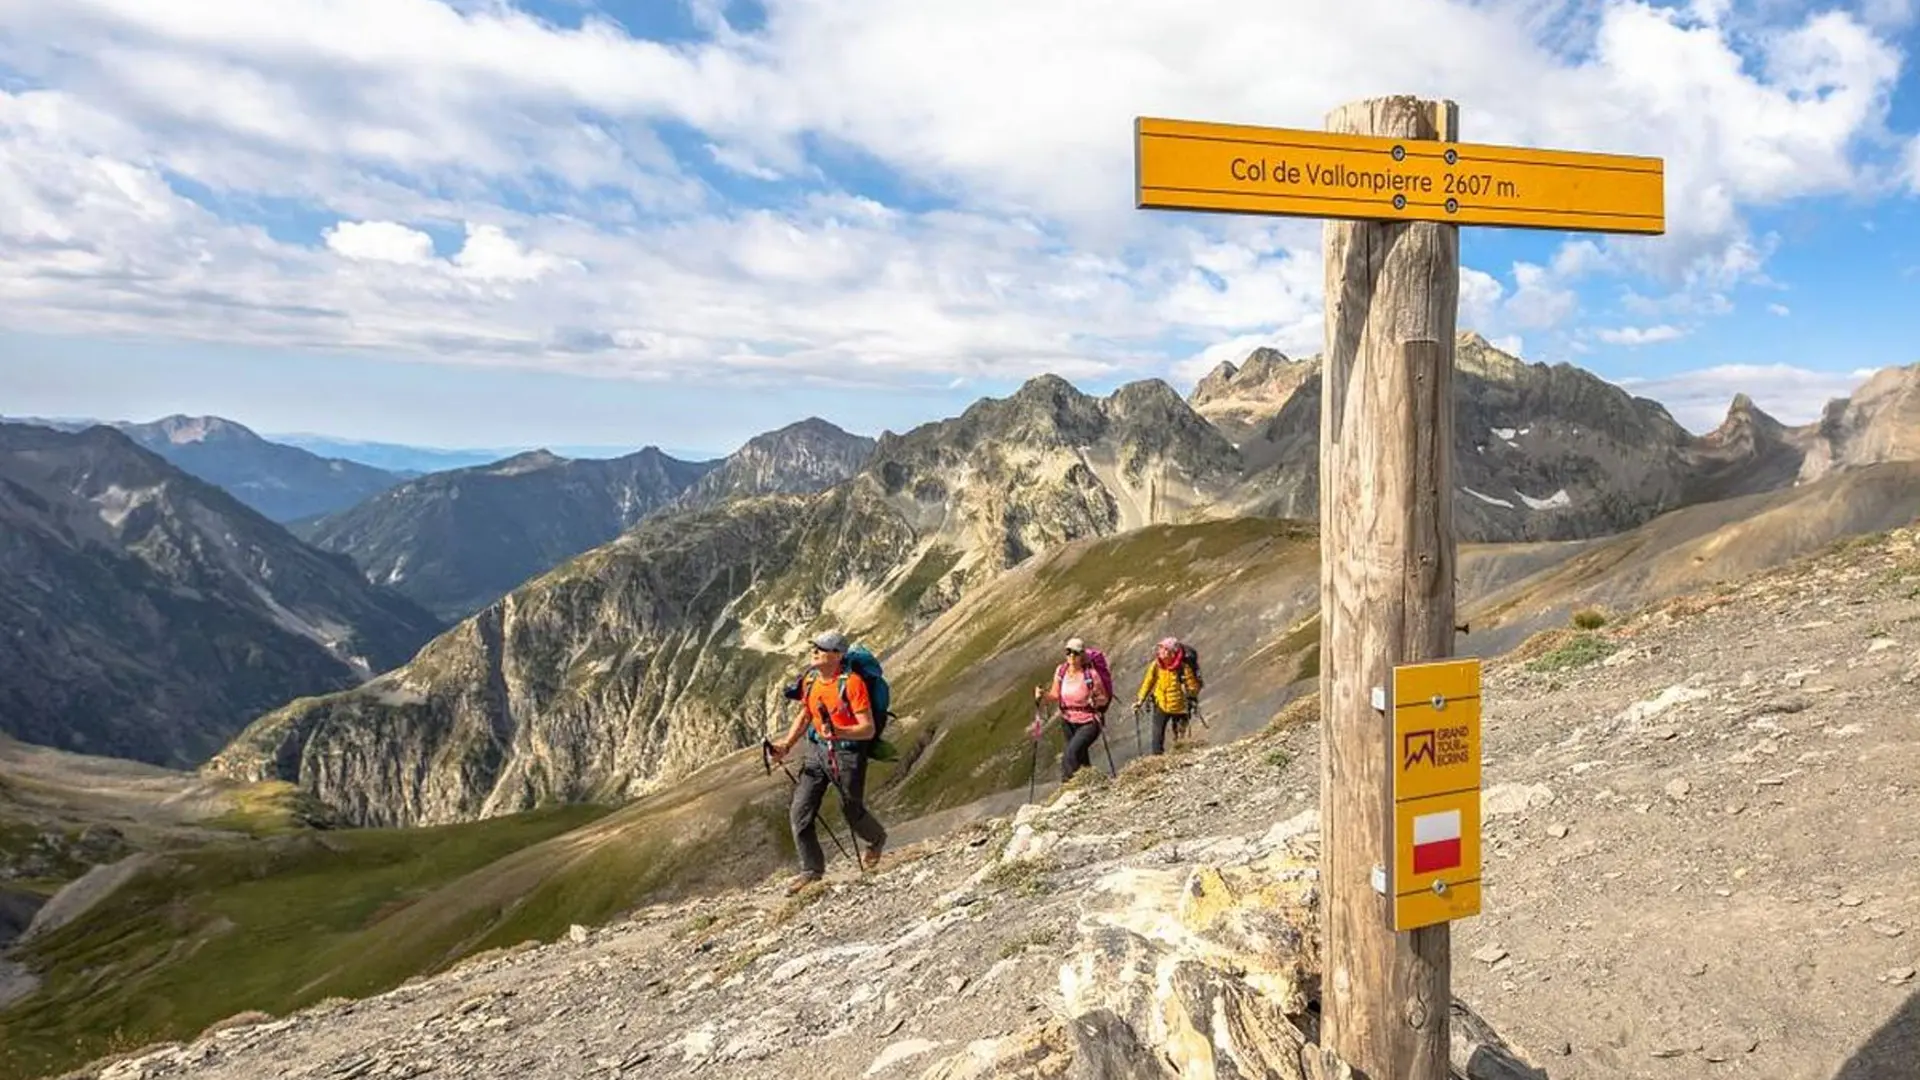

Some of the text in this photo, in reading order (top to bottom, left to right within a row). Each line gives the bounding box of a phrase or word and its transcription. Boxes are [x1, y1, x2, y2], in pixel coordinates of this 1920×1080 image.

[1231, 158, 1520, 198] Col de Vallonpierre 2607 m.
[1438, 726, 1469, 740] GRAND
[1438, 740, 1461, 754] TOUR
